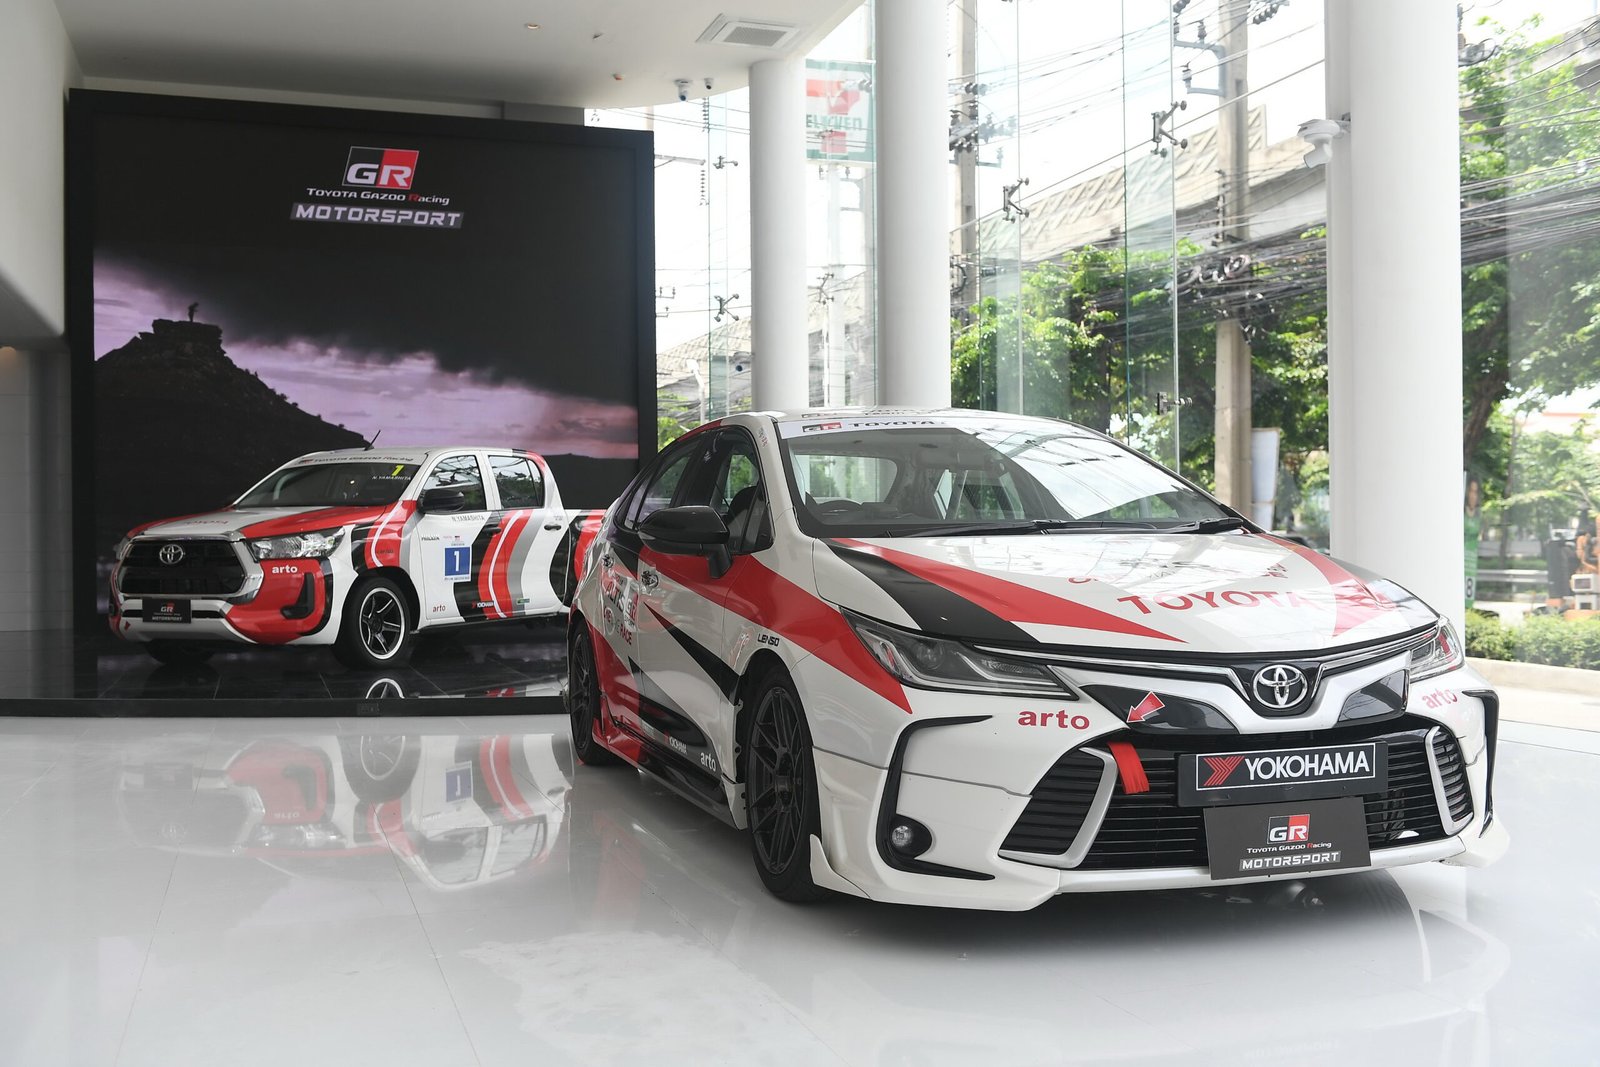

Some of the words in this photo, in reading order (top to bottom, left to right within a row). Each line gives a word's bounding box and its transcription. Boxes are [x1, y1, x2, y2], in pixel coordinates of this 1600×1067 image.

[346, 163, 412, 187] GR
[306, 187, 358, 199] TOYOTA
[360, 191, 406, 201] GAZOO
[408, 193, 450, 206] Racing
[295, 204, 461, 227] MOTORSPORT
[848, 420, 935, 428] TOYOTA
[391, 465, 405, 477] 1
[272, 564, 298, 574] arto
[454, 551, 460, 572] 1
[432, 604, 446, 613] arto
[1117, 591, 1323, 614] TOYOTA
[757, 633, 780, 647] LENSO
[1421, 688, 1458, 709] arto
[1018, 710, 1091, 730] arto
[700, 752, 717, 772] arto
[1245, 750, 1370, 781] YOKOHAMA
[1269, 825, 1308, 843] GR
[1307, 841, 1332, 849] Racing
[1242, 852, 1340, 870] MOTORSPORT
